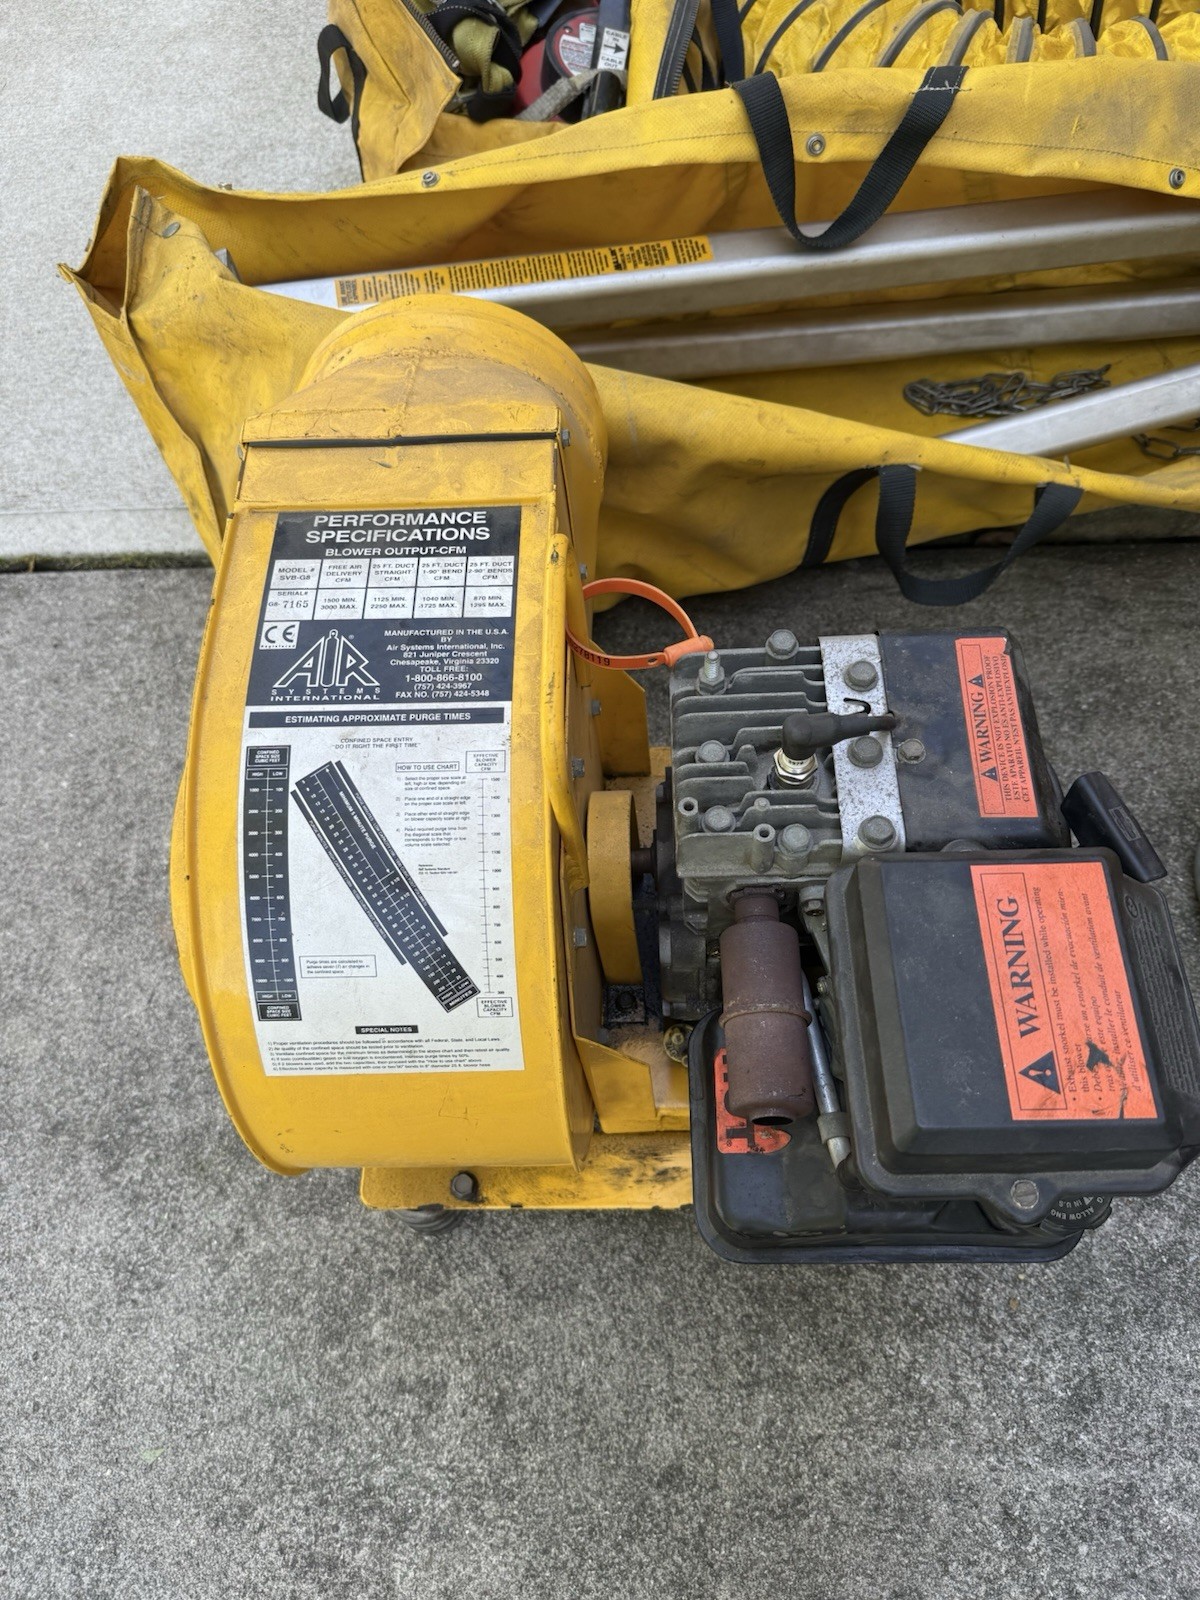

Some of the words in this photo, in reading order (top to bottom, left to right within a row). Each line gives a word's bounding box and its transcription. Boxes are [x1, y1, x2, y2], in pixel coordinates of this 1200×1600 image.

[314, 511, 487, 527] PERFORMANCE
[306, 528, 490, 543] SPECIFICATIONS
[325, 548, 381, 557] BLOWER
[385, 546, 467, 555] OUTPUT-CFM
[283, 600, 309, 609] 7165
[400, 644, 435, 652] Systems
[436, 643, 489, 651] International,
[419, 651, 446, 659] Juniper
[274, 629, 381, 688] AIR
[390, 658, 441, 667] Chesapeake,
[443, 658, 474, 666] Virginia
[984, 655, 993, 680] PROOF
[406, 673, 482, 682] 1-800-866-8100
[436, 682, 472, 690] 424-3967
[992, 655, 1008, 718] ANTI-EXPLOSIVO
[395, 691, 411, 699] FAX
[432, 691, 452, 699] (757)
[987, 681, 1000, 724] EXPLOSION
[285, 715, 340, 724] ESTIMATING
[342, 714, 407, 722] APPROXIMATE
[409, 713, 441, 722] PURGE
[442, 713, 471, 721] TIMES
[1001, 719, 1009, 728] ES
[1008, 708, 1017, 722] PAS
[970, 692, 993, 763] WARNING
[995, 726, 1003, 741] NOT
[1003, 730, 1011, 741] NO
[999, 751, 1011, 782] DEVICE
[1005, 742, 1016, 779] APARATO
[1014, 747, 1028, 785] APPAREIL
[1003, 784, 1012, 801] THIS
[1012, 781, 1021, 800] ESTE
[1022, 787, 1030, 802] CET
[1031, 886, 1047, 924] operating
[1055, 888, 1066, 911] mien-
[1081, 892, 1092, 915] avant
[1038, 925, 1050, 948] while
[1058, 913, 1075, 958] evacuación
[1086, 917, 1100, 960] ventilation
[996, 897, 1041, 1038] WARNING
[1042, 950, 1057, 985] installed
[1069, 960, 1078, 971] de
[1094, 962, 1103, 972] de
[1050, 987, 1058, 997] be
[1072, 973, 1086, 1009] esnorkel
[1097, 974, 1110, 1005] conduit
[1053, 999, 1064, 1021] must
[1080, 1010, 1087, 1021] un
[1091, 996, 1103, 1025] equipo
[1103, 1007, 1112, 1016] le
[1113, 989, 1129, 1035] ventilateur
[1056, 1023, 1071, 1055] snorkel
[1098, 1027, 1106, 1044] este
[1105, 1018, 1121, 1055] installer
[1123, 1037, 1132, 1048] ce
[1074, 1043, 1086, 1074] blower
[1063, 1057, 1078, 1093] Exhaust
[1126, 1051, 1141, 1092] d'utiliser
[1080, 1076, 1090, 1093] this
[1074, 1199, 1082, 1207] IN
[1069, 1207, 1094, 1220] ALLOW
